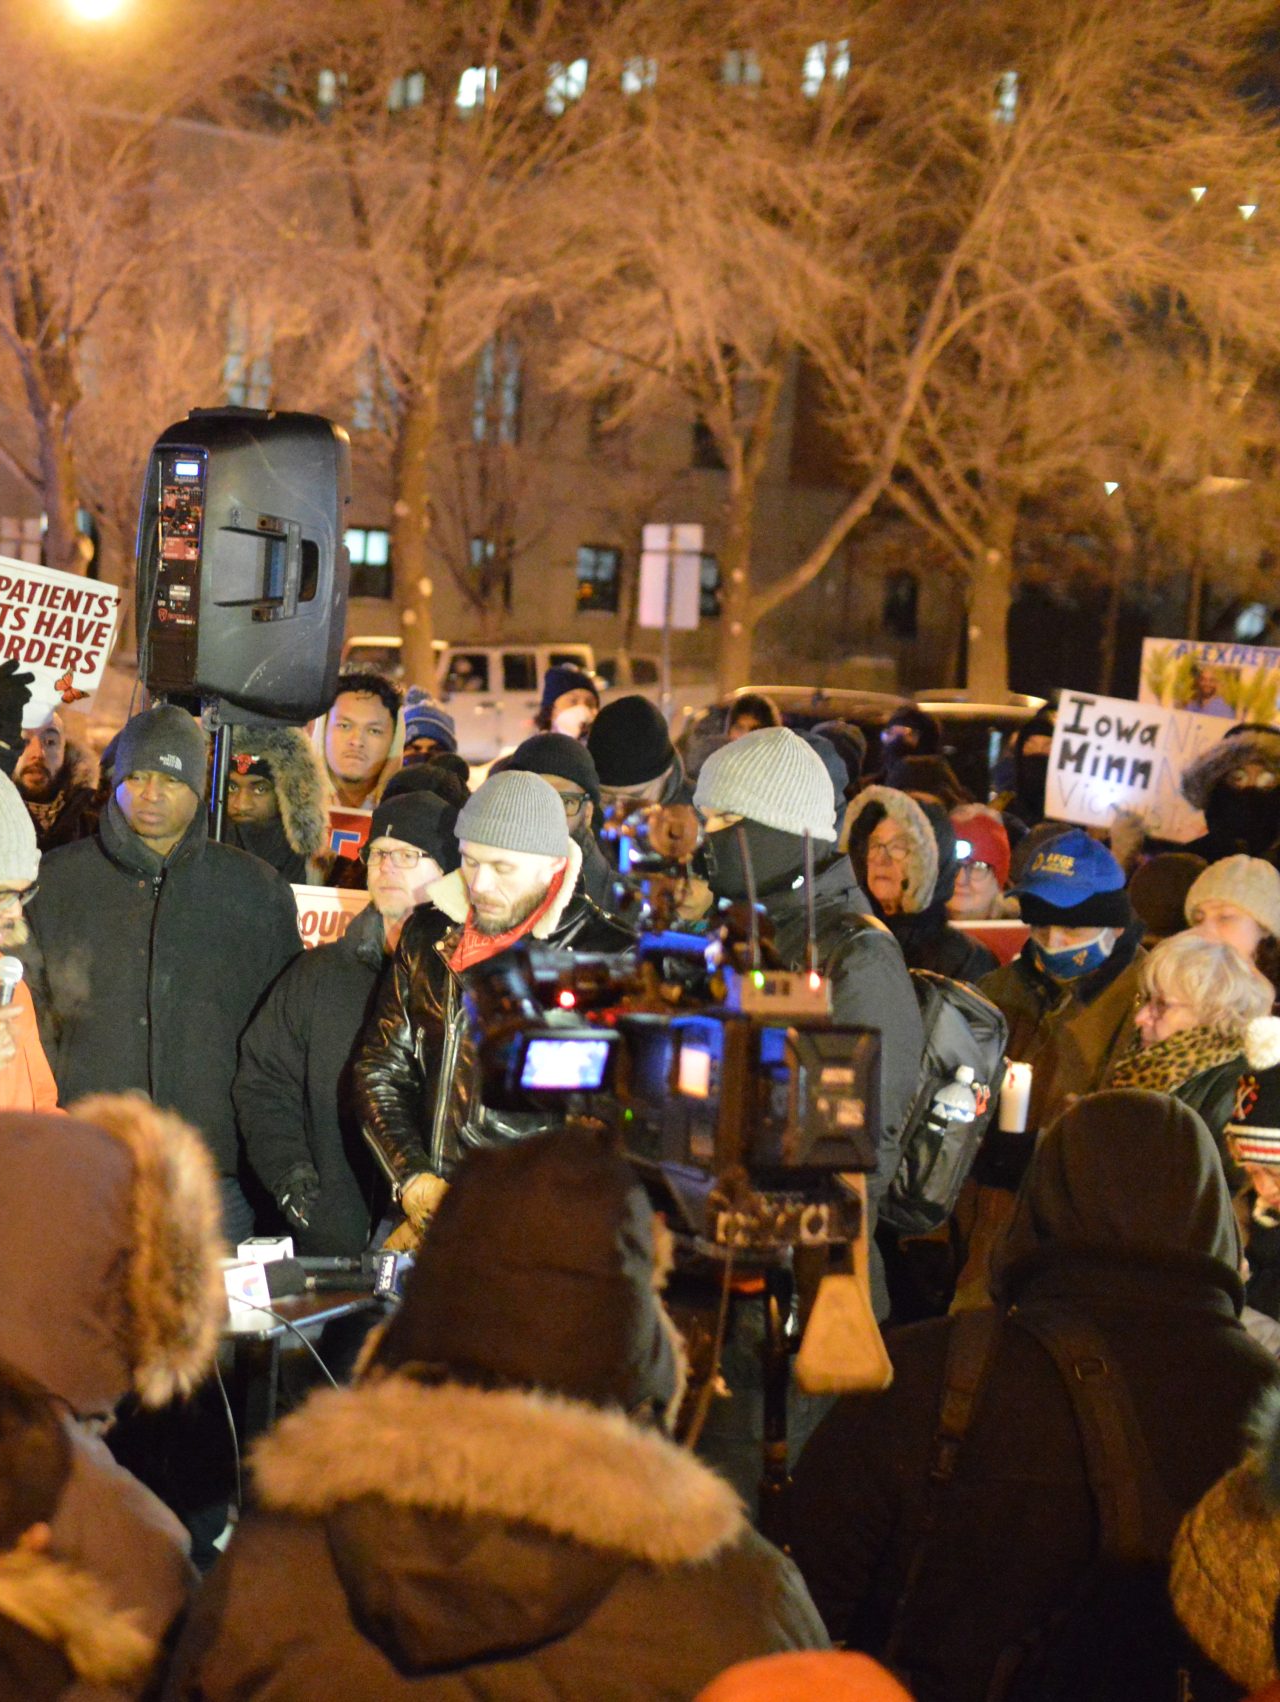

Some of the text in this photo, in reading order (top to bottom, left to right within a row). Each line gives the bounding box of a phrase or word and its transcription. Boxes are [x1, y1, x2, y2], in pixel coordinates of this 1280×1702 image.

[32, 611, 112, 648] HAVE
[1062, 697, 1160, 748] Iowa
[1057, 739, 1153, 789] Minn
